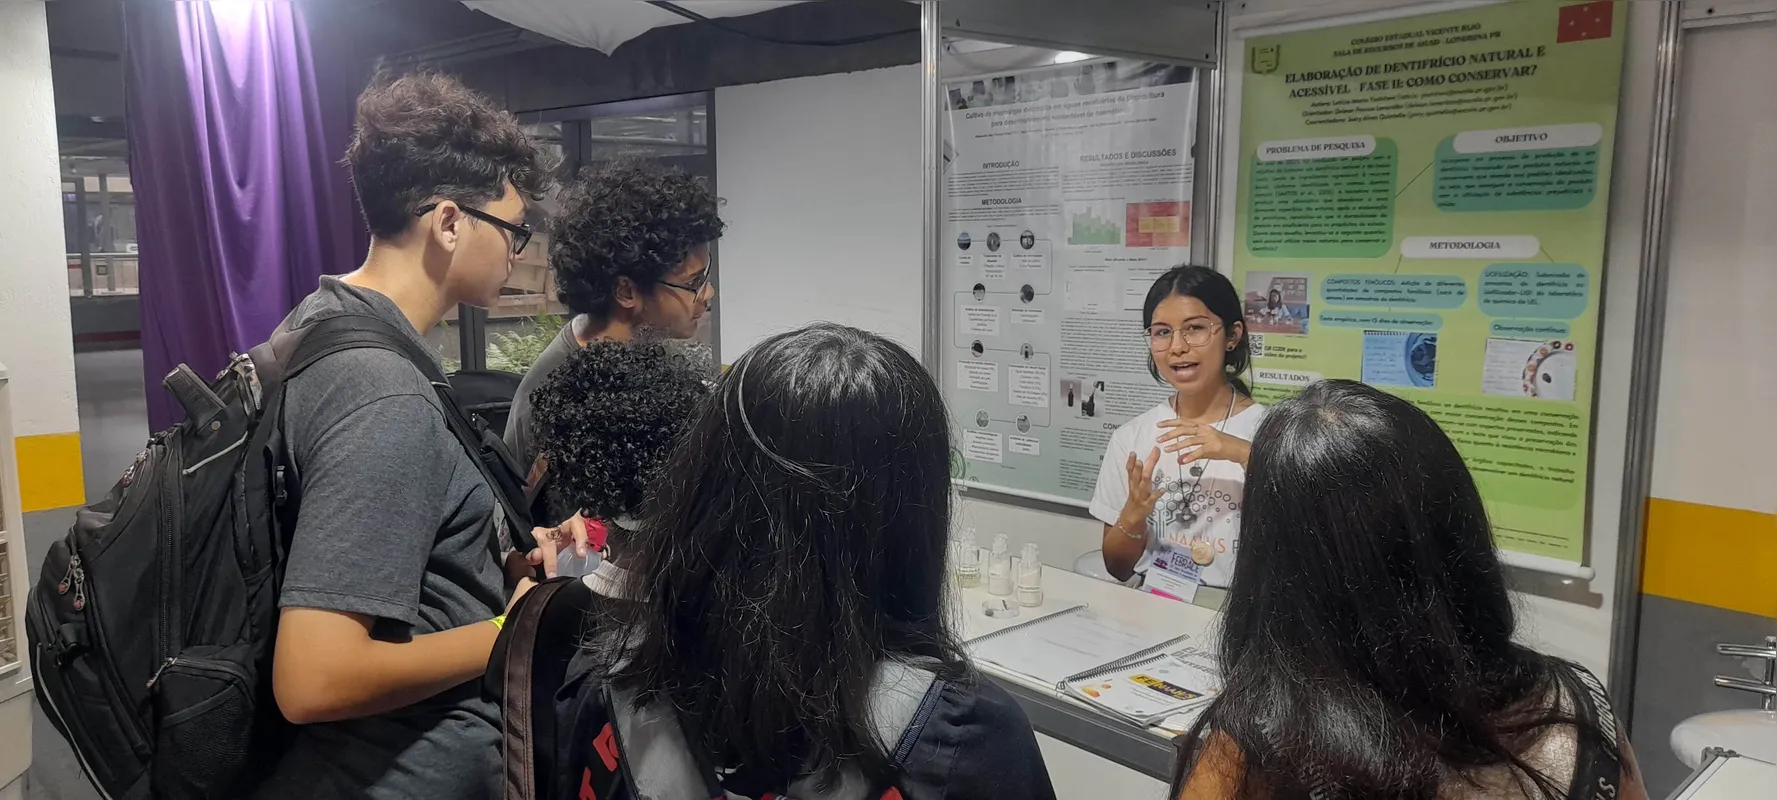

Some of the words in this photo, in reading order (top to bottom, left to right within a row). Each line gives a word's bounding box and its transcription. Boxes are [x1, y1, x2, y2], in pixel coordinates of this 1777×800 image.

[1385, 30, 1424, 42] ESTADUAL
[1426, 26, 1460, 37] VICENTE
[1285, 66, 1363, 84] ELABORAÇÃO
[1365, 64, 1382, 76] DE
[1383, 54, 1467, 74] DENTIFRÍCIO
[1468, 48, 1534, 64] NATURAL
[1535, 46, 1546, 58] E
[1289, 84, 1351, 99] ACESSÍVEL
[1360, 80, 1389, 93] FASE
[1406, 74, 1446, 88] COMO
[1448, 64, 1538, 84] CONSERVAR?
[966, 112, 984, 120] Cultivo
[1494, 133, 1548, 144] OBJETIVO
[1266, 144, 1309, 154] PROBLEMA
[1311, 144, 1322, 152] DE
[1324, 141, 1366, 151] PESQUISA
[1080, 152, 1124, 163] RESULTADOS
[1131, 148, 1177, 159] DISCUSSÕES
[982, 160, 1020, 169] INTRODUÇÃO
[982, 198, 1022, 206] METODOLOGIA
[1430, 242, 1501, 250] METODOLOGIA
[1260, 372, 1310, 382] RESULTADOS
